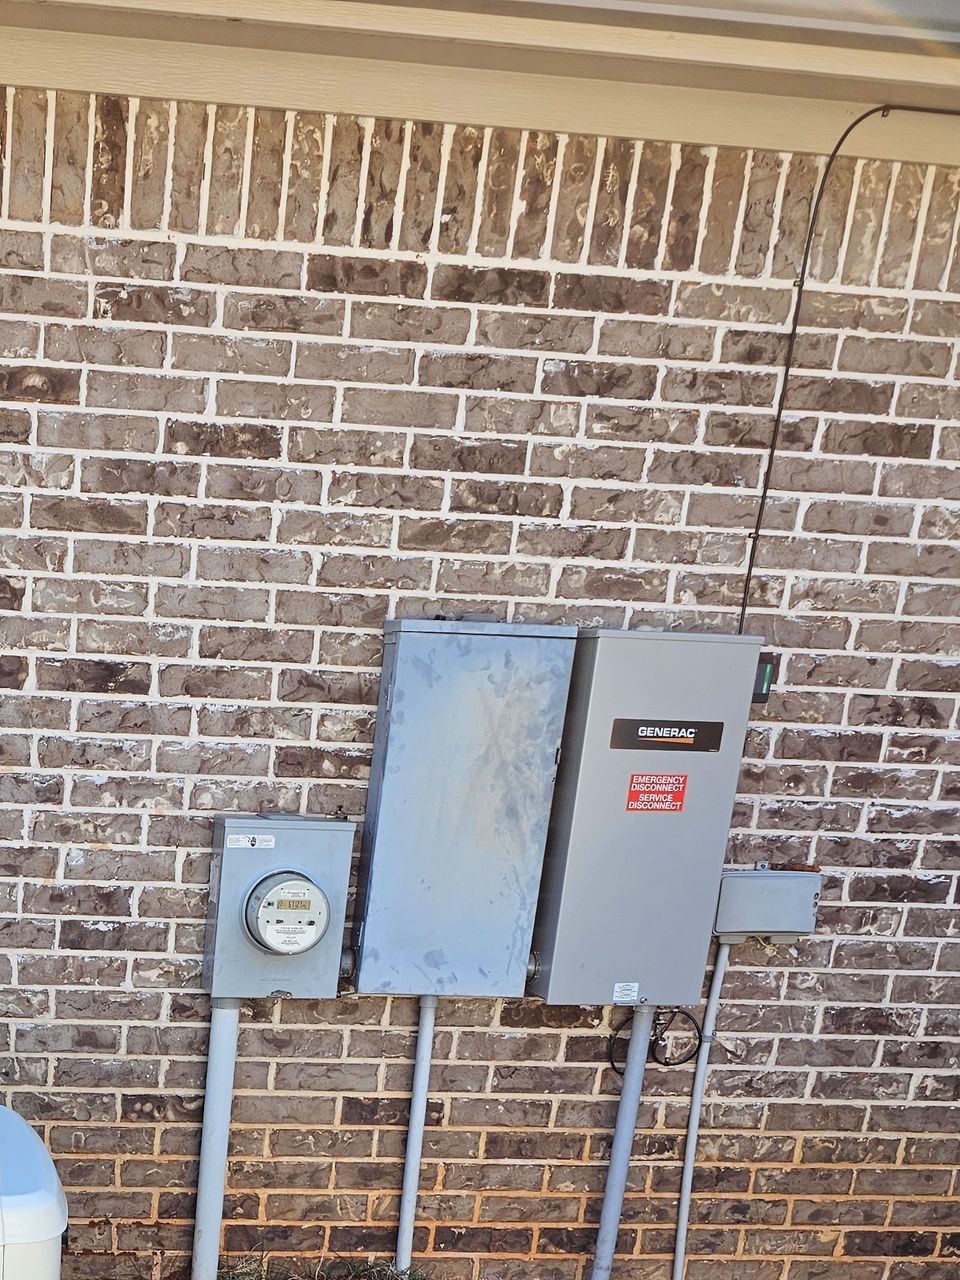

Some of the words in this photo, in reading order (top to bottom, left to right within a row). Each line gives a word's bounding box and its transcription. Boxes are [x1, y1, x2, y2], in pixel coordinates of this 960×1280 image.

[638, 727, 695, 738] GENERAC
[632, 775, 685, 783] EMERGENCY
[631, 784, 684, 792] DISCONNECT
[638, 794, 673, 802] SERVICE
[628, 802, 681, 810] DISCONNECT
